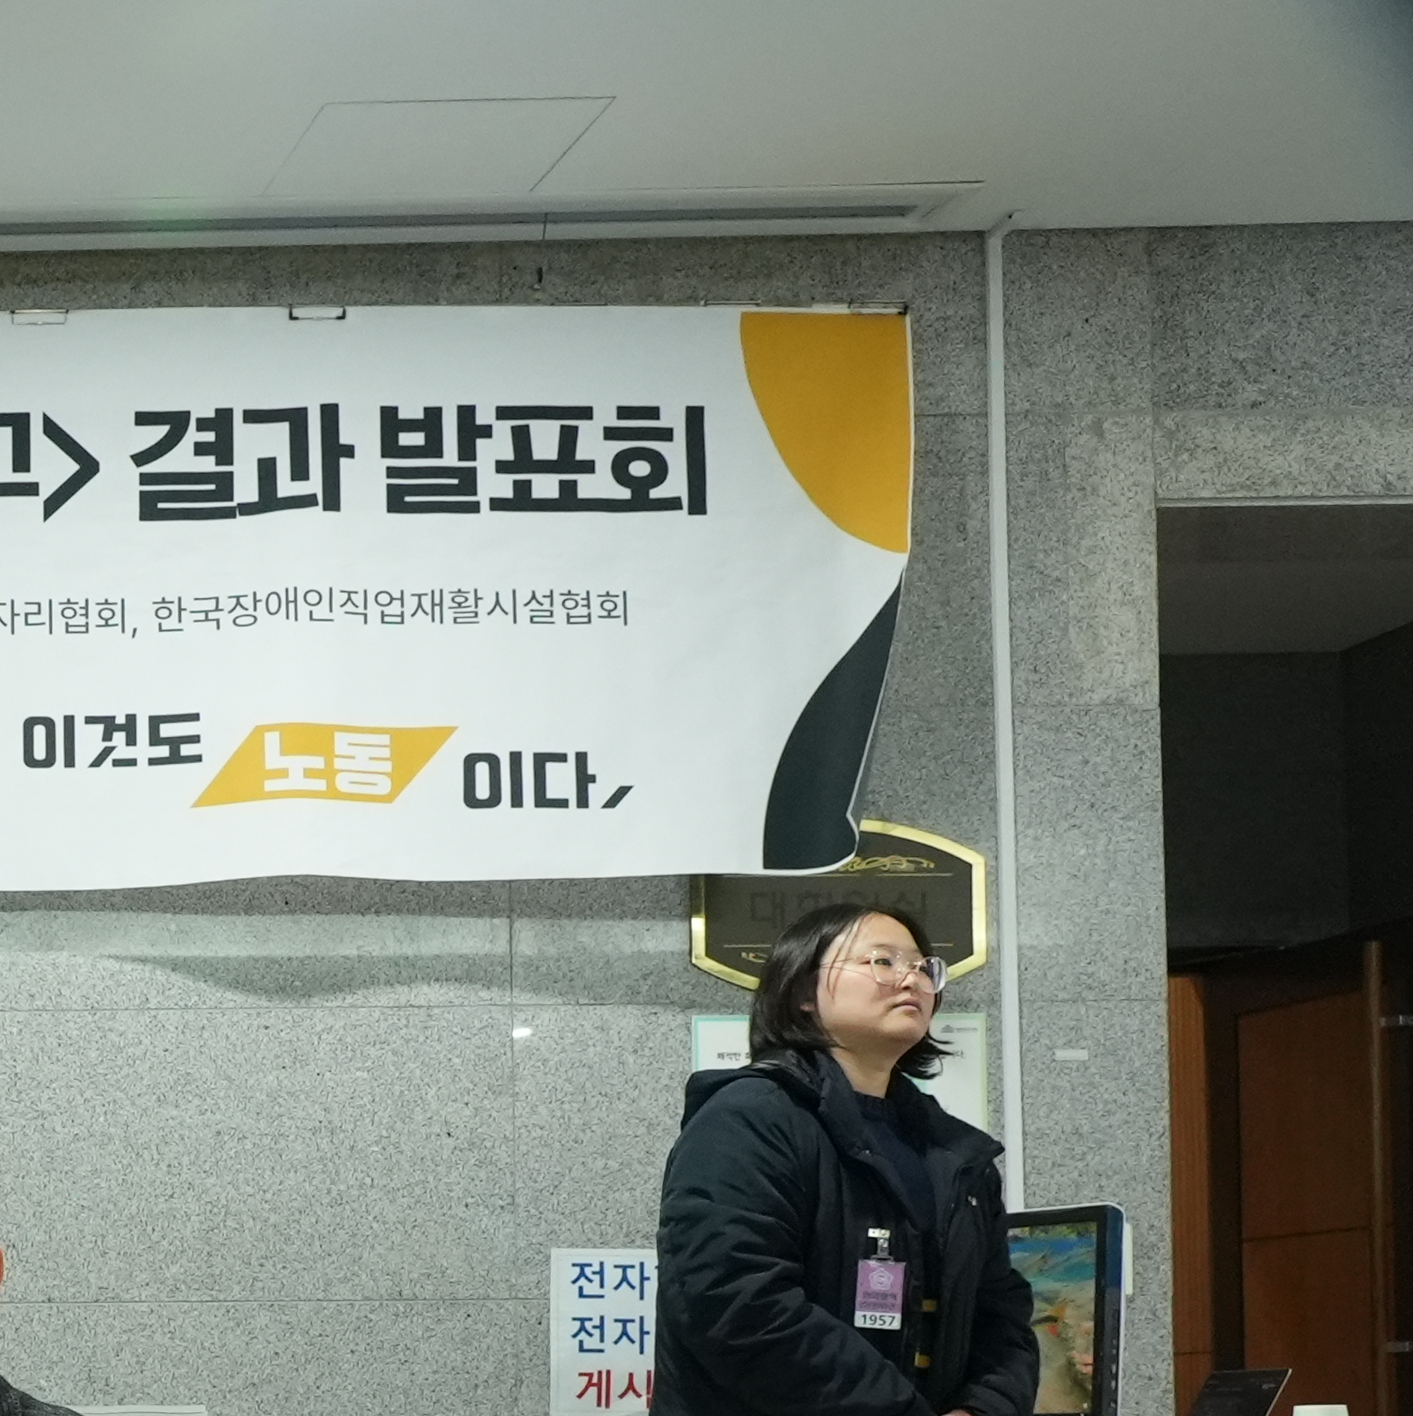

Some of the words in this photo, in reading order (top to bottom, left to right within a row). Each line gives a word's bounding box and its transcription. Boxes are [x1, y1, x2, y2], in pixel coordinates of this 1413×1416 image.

[130, 403, 355, 521] 결과
[380, 405, 707, 515] 발표회
[153, 587, 627, 632] 한국장애인직업재활시설협회
[23, 713, 202, 768] 이것도
[263, 731, 393, 795] 노동
[571, 1315, 651, 1355] 전자
[861, 1314, 895, 1326] 1957
